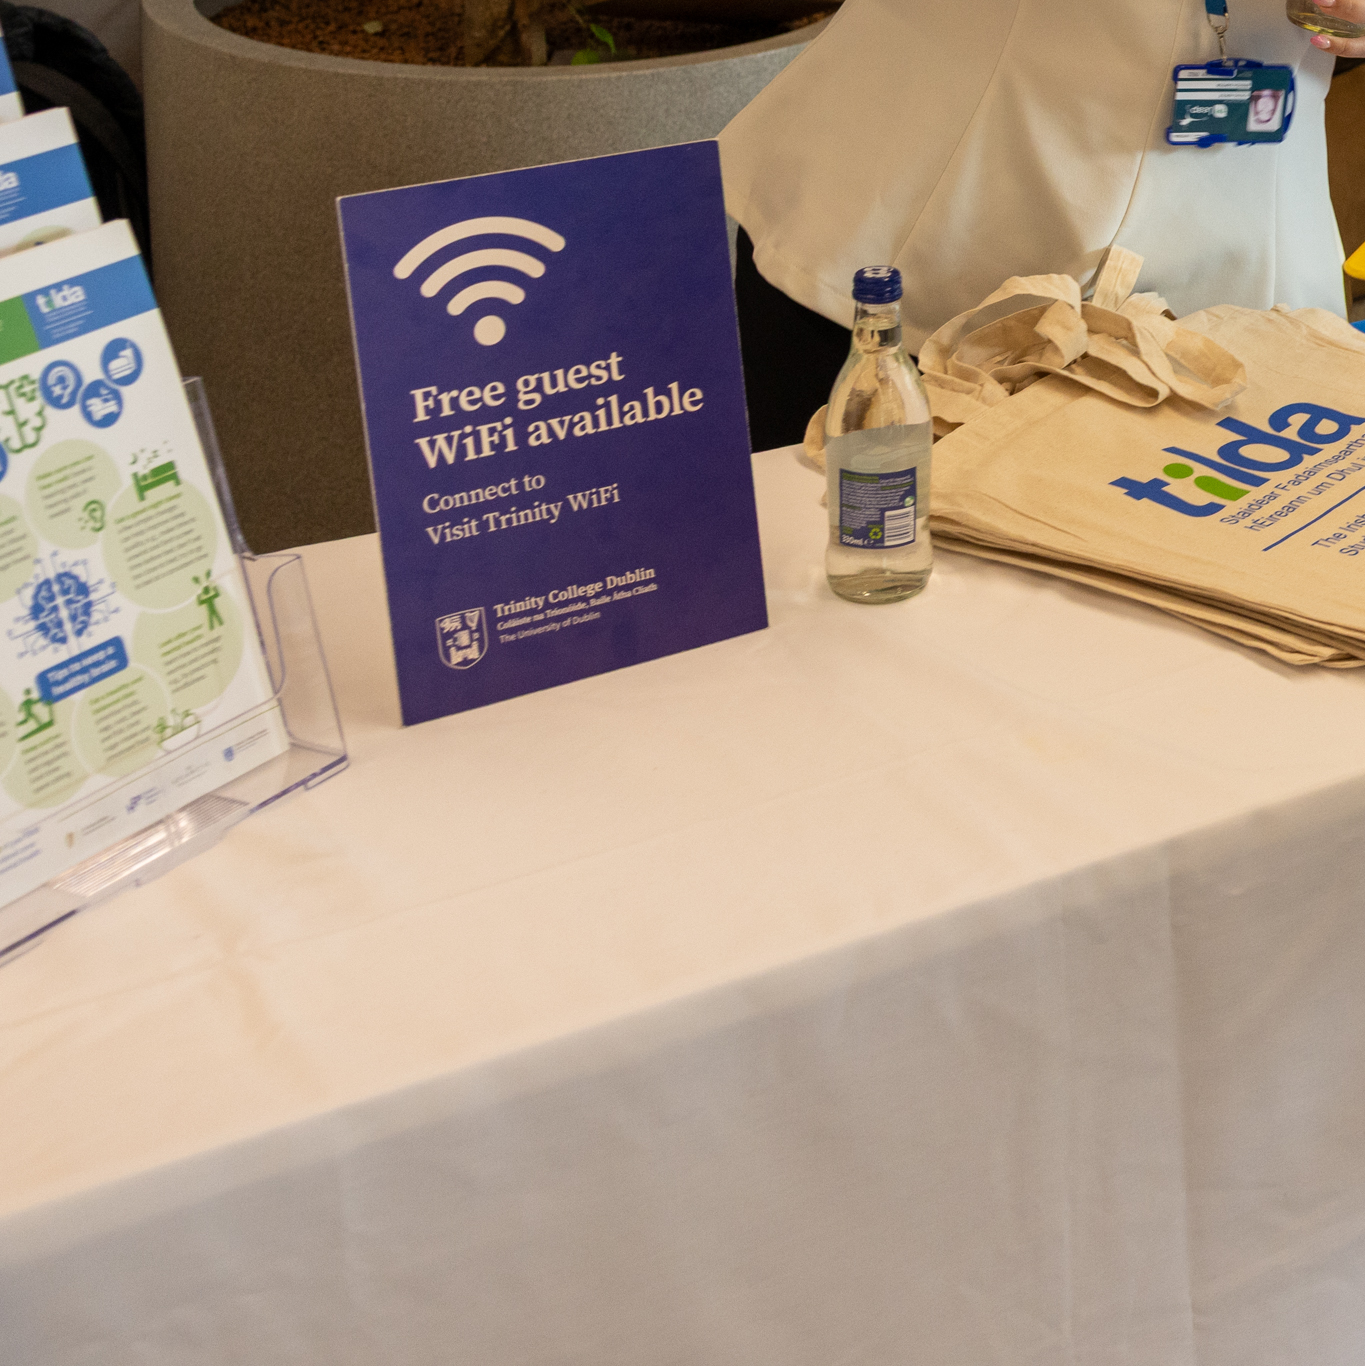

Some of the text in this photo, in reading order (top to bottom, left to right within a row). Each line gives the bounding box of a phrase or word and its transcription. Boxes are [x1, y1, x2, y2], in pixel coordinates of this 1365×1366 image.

[35, 284, 86, 313] tilda
[410, 352, 625, 422] Free guest
[415, 382, 704, 469] WiFi available
[422, 474, 546, 514] Connect to
[1219, 486, 1284, 526] Staidéar
[1244, 494, 1309, 531] hÉireann
[1306, 480, 1331, 501] um
[1327, 455, 1365, 483] Dhul
[426, 483, 620, 545] Visit Trinity WiFi
[1311, 530, 1347, 551] The
[493, 567, 656, 617] Trinity College Dublin
[499, 611, 601, 644] The University of Dublin
[533, 613, 544, 622] na
